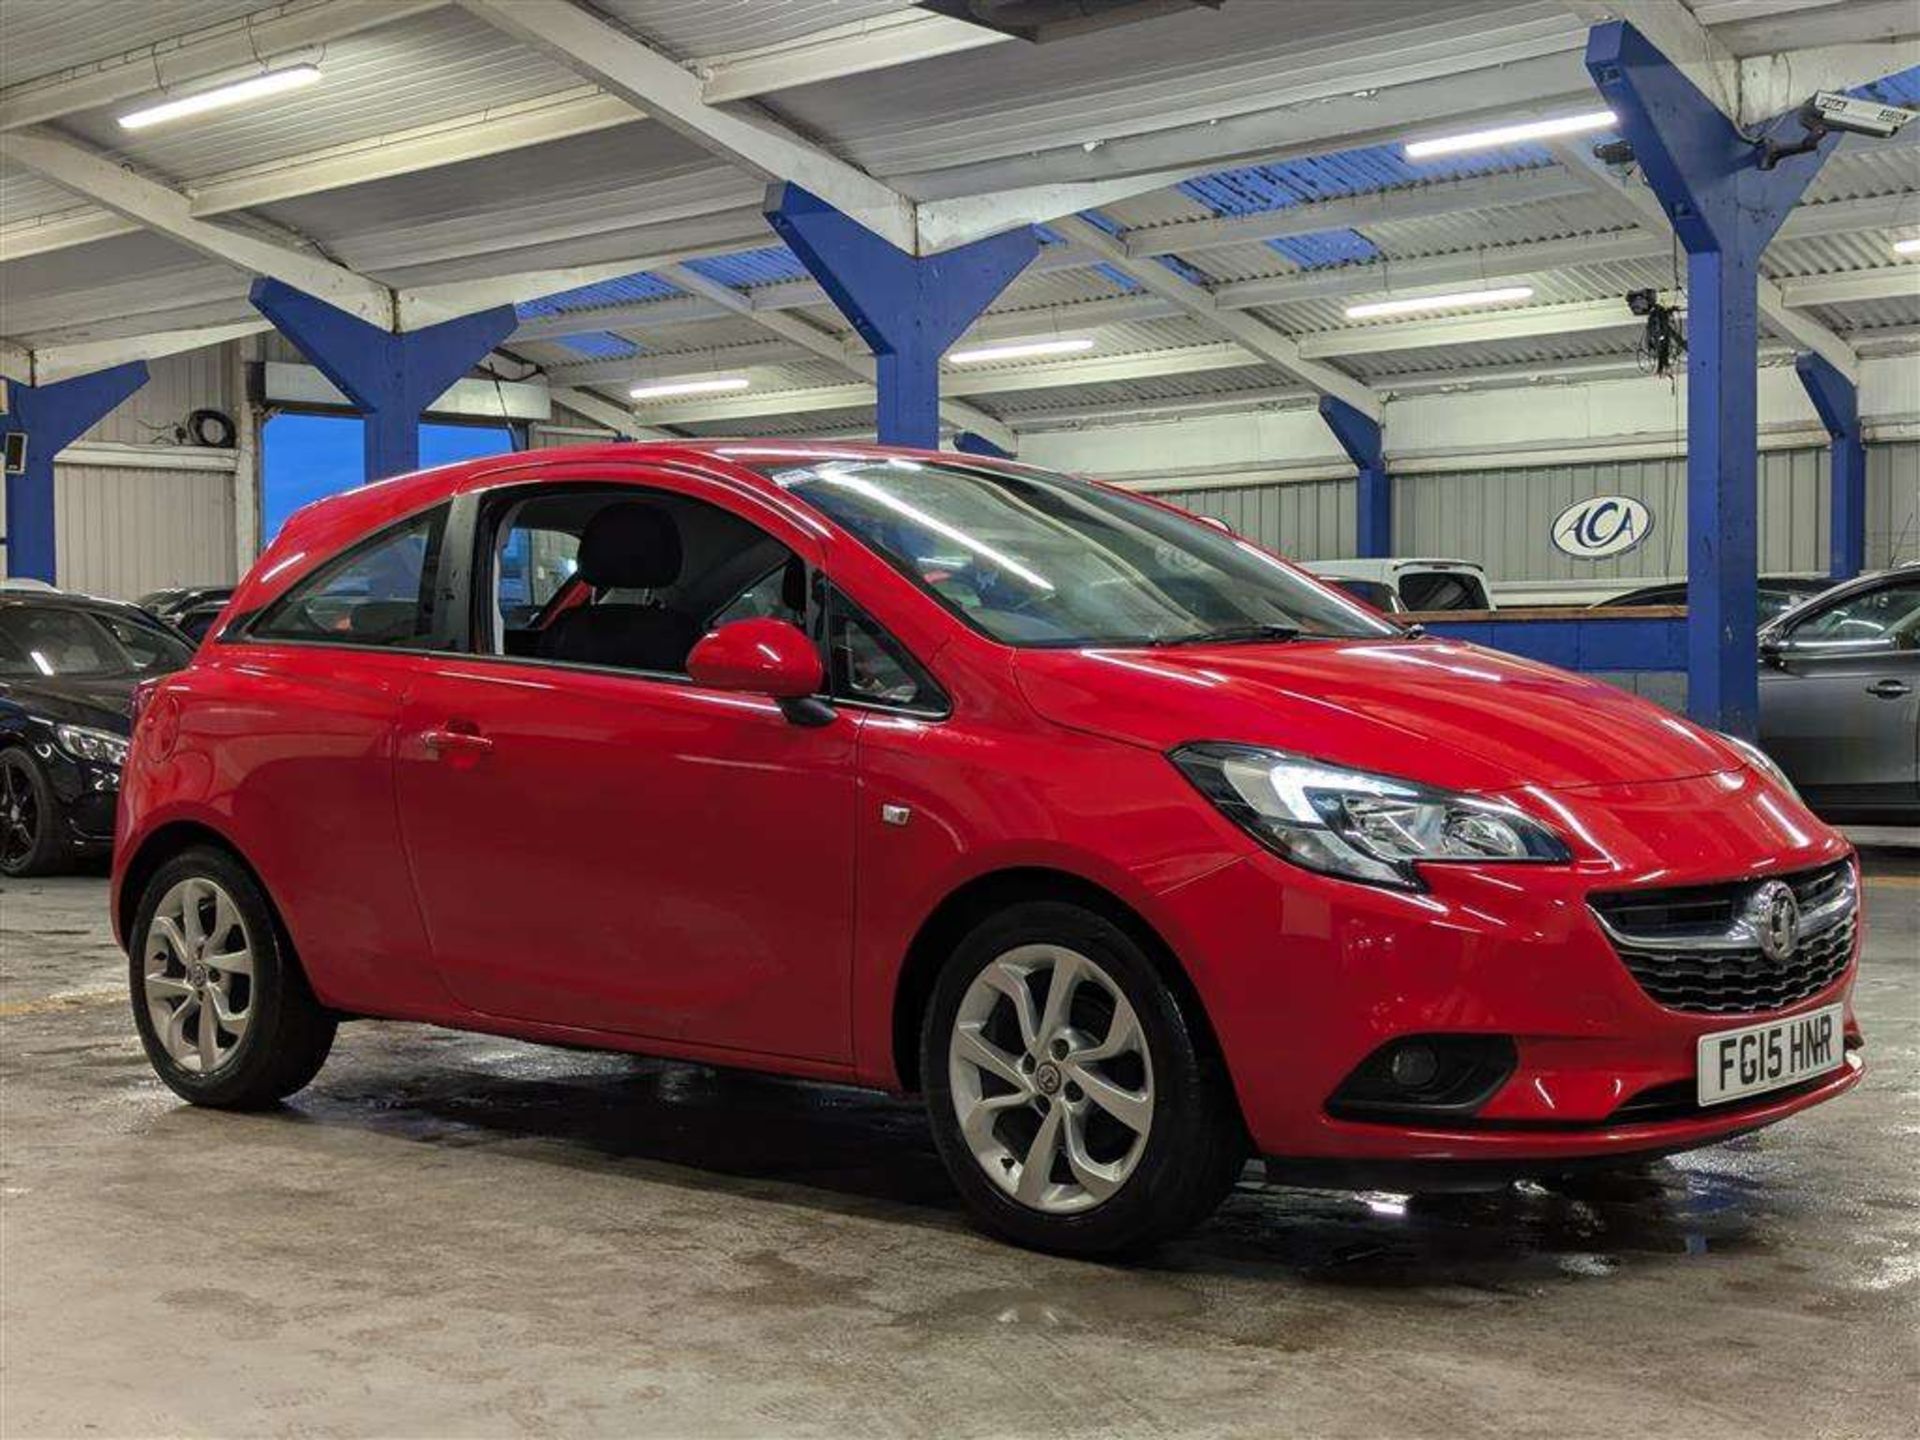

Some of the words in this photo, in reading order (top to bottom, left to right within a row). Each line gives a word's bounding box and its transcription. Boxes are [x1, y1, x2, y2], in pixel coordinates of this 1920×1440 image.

[1559, 501, 1635, 549] ACA
[1719, 1027, 1783, 1091] FG15
[1790, 1013, 1833, 1073] HNR
